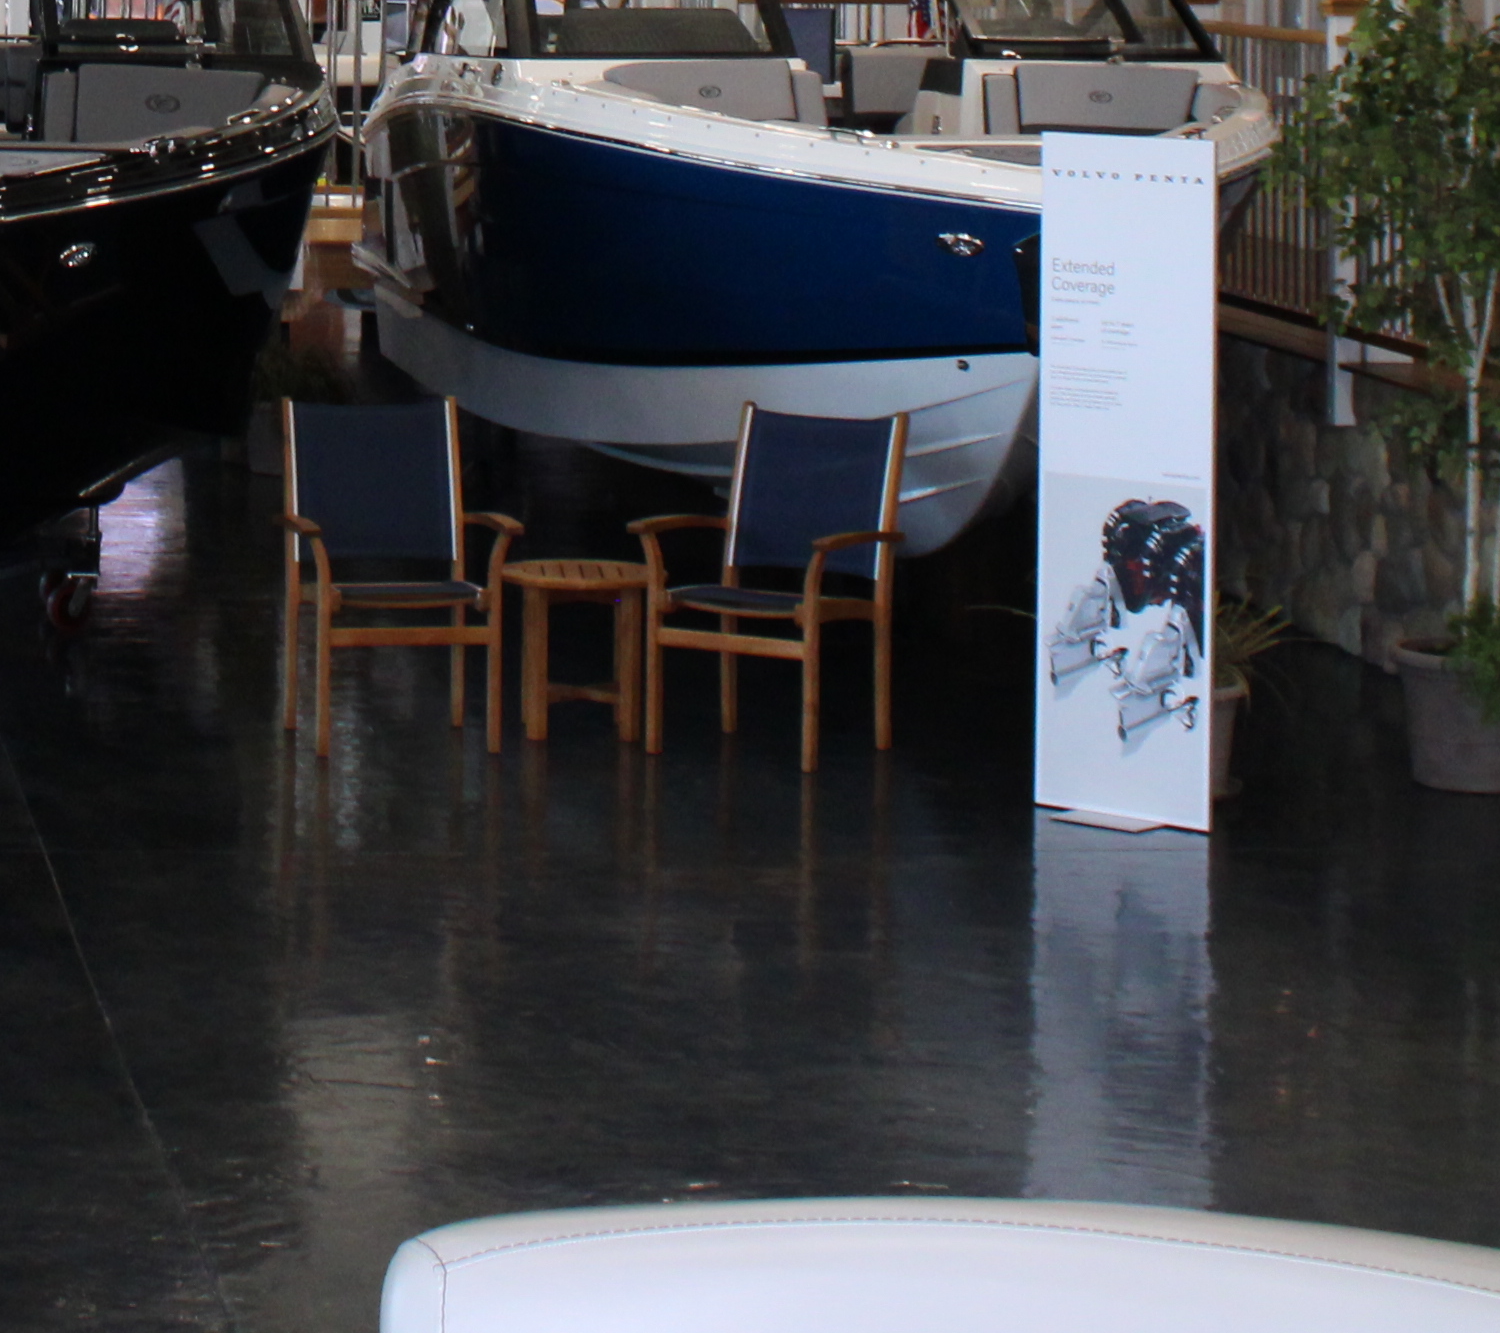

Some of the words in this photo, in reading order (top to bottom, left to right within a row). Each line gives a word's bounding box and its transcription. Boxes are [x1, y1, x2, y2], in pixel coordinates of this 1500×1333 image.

[1052, 169, 1120, 180] VOLVO
[1134, 173, 1204, 185] PENTA
[1052, 257, 1115, 276] Extended
[1051, 276, 1115, 297] Coverage
